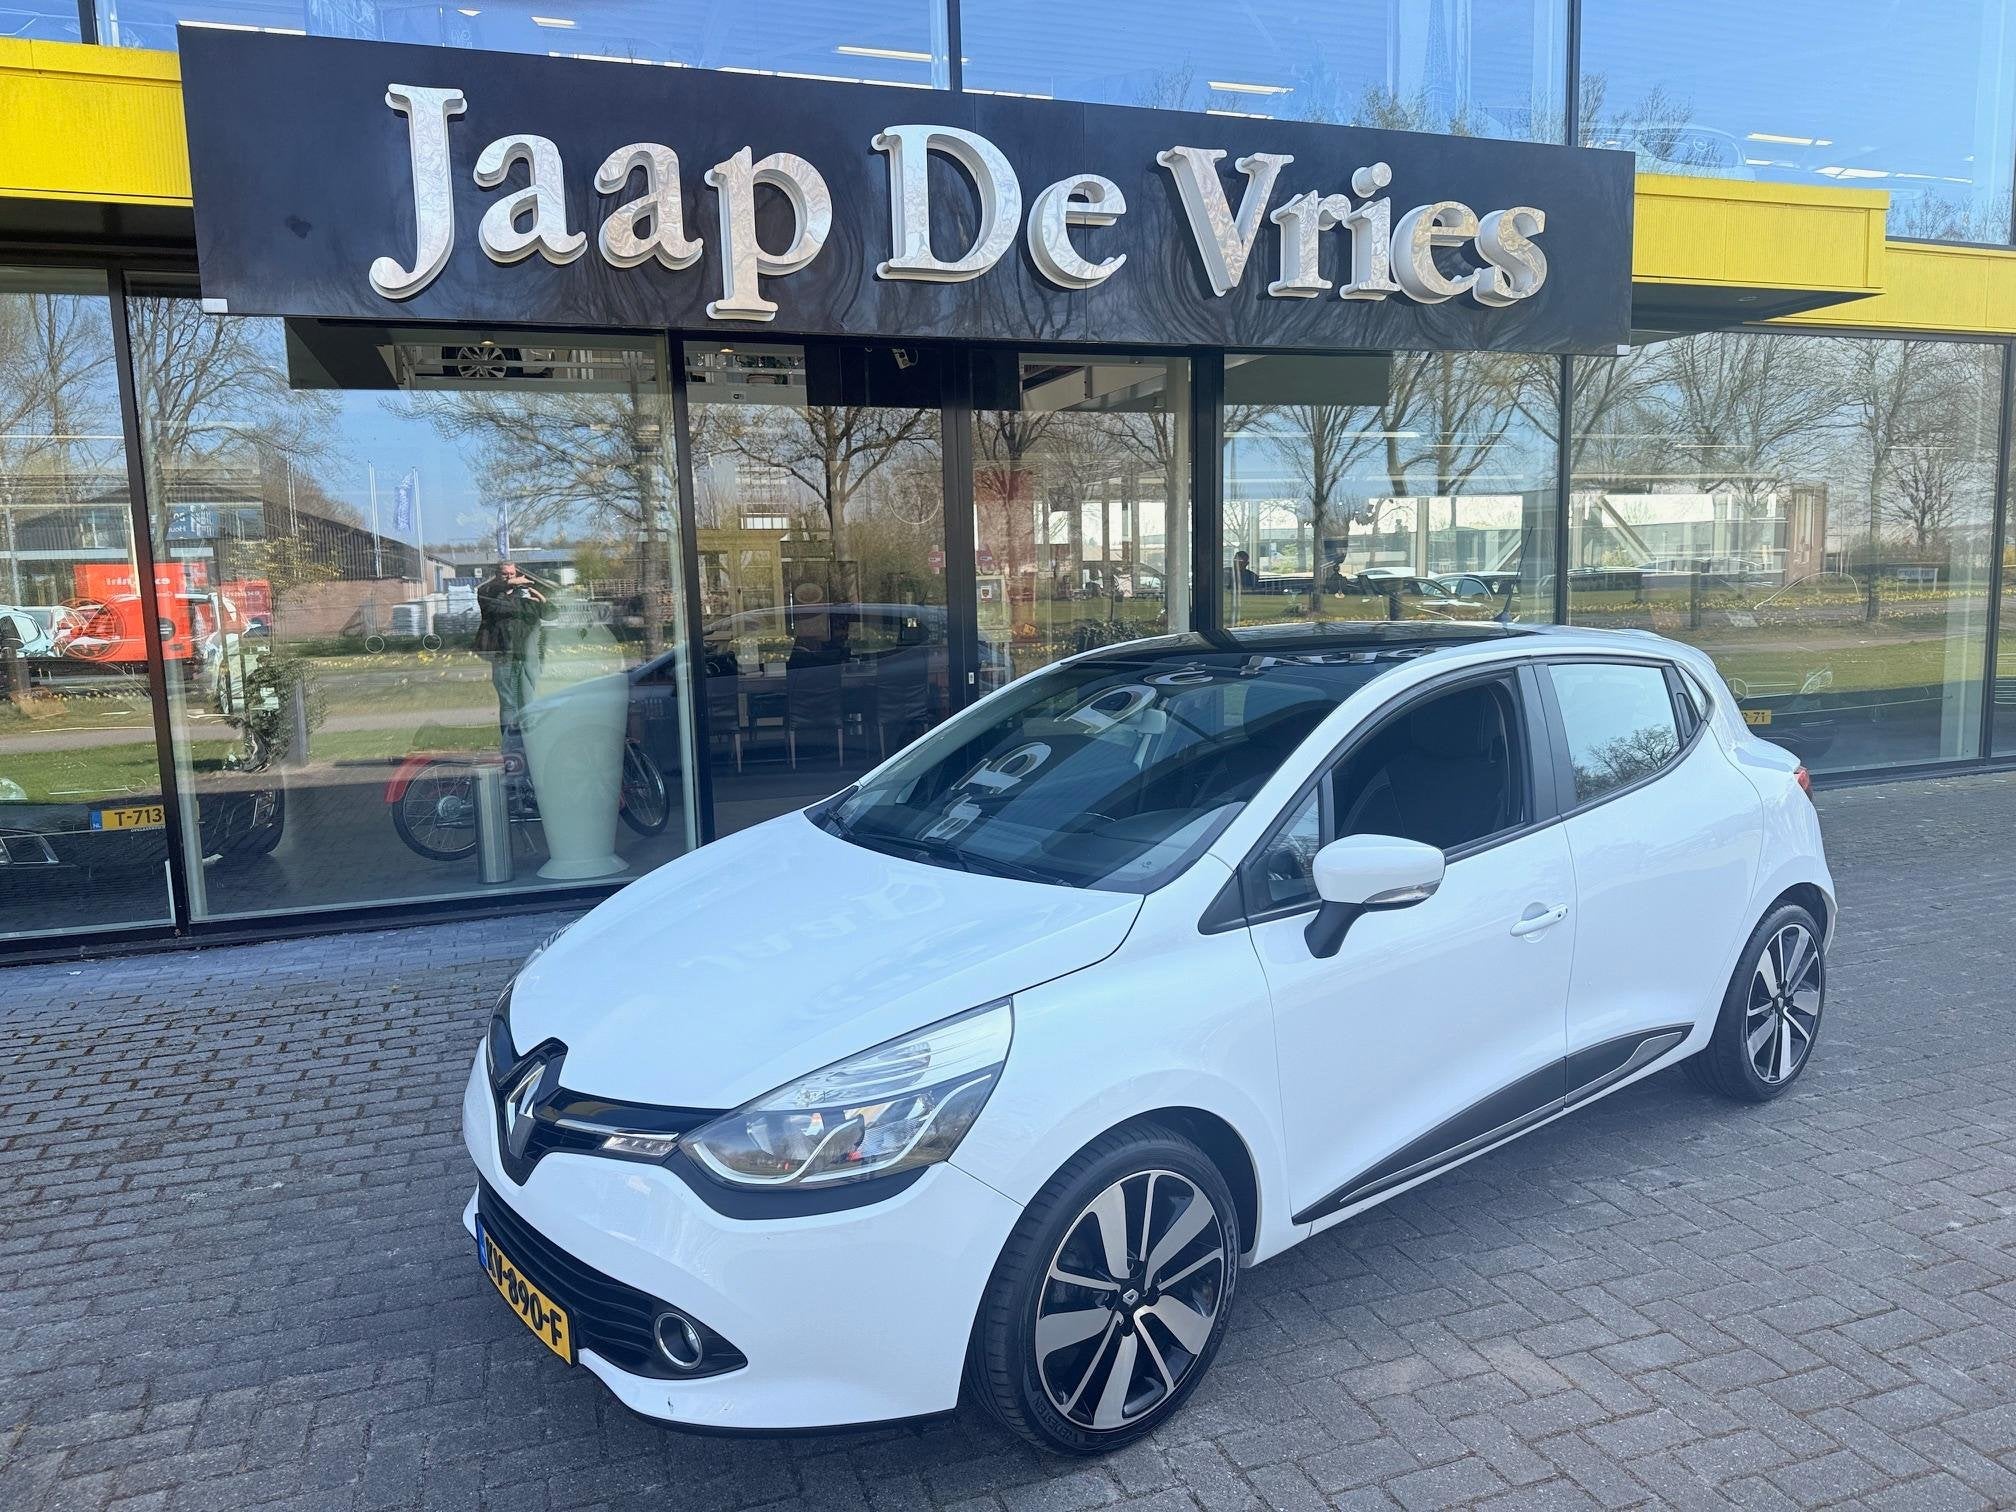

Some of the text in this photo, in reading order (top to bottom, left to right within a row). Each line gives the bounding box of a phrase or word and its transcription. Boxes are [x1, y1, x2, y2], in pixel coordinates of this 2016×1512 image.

[369, 83, 1548, 322] Jaap De Vries
